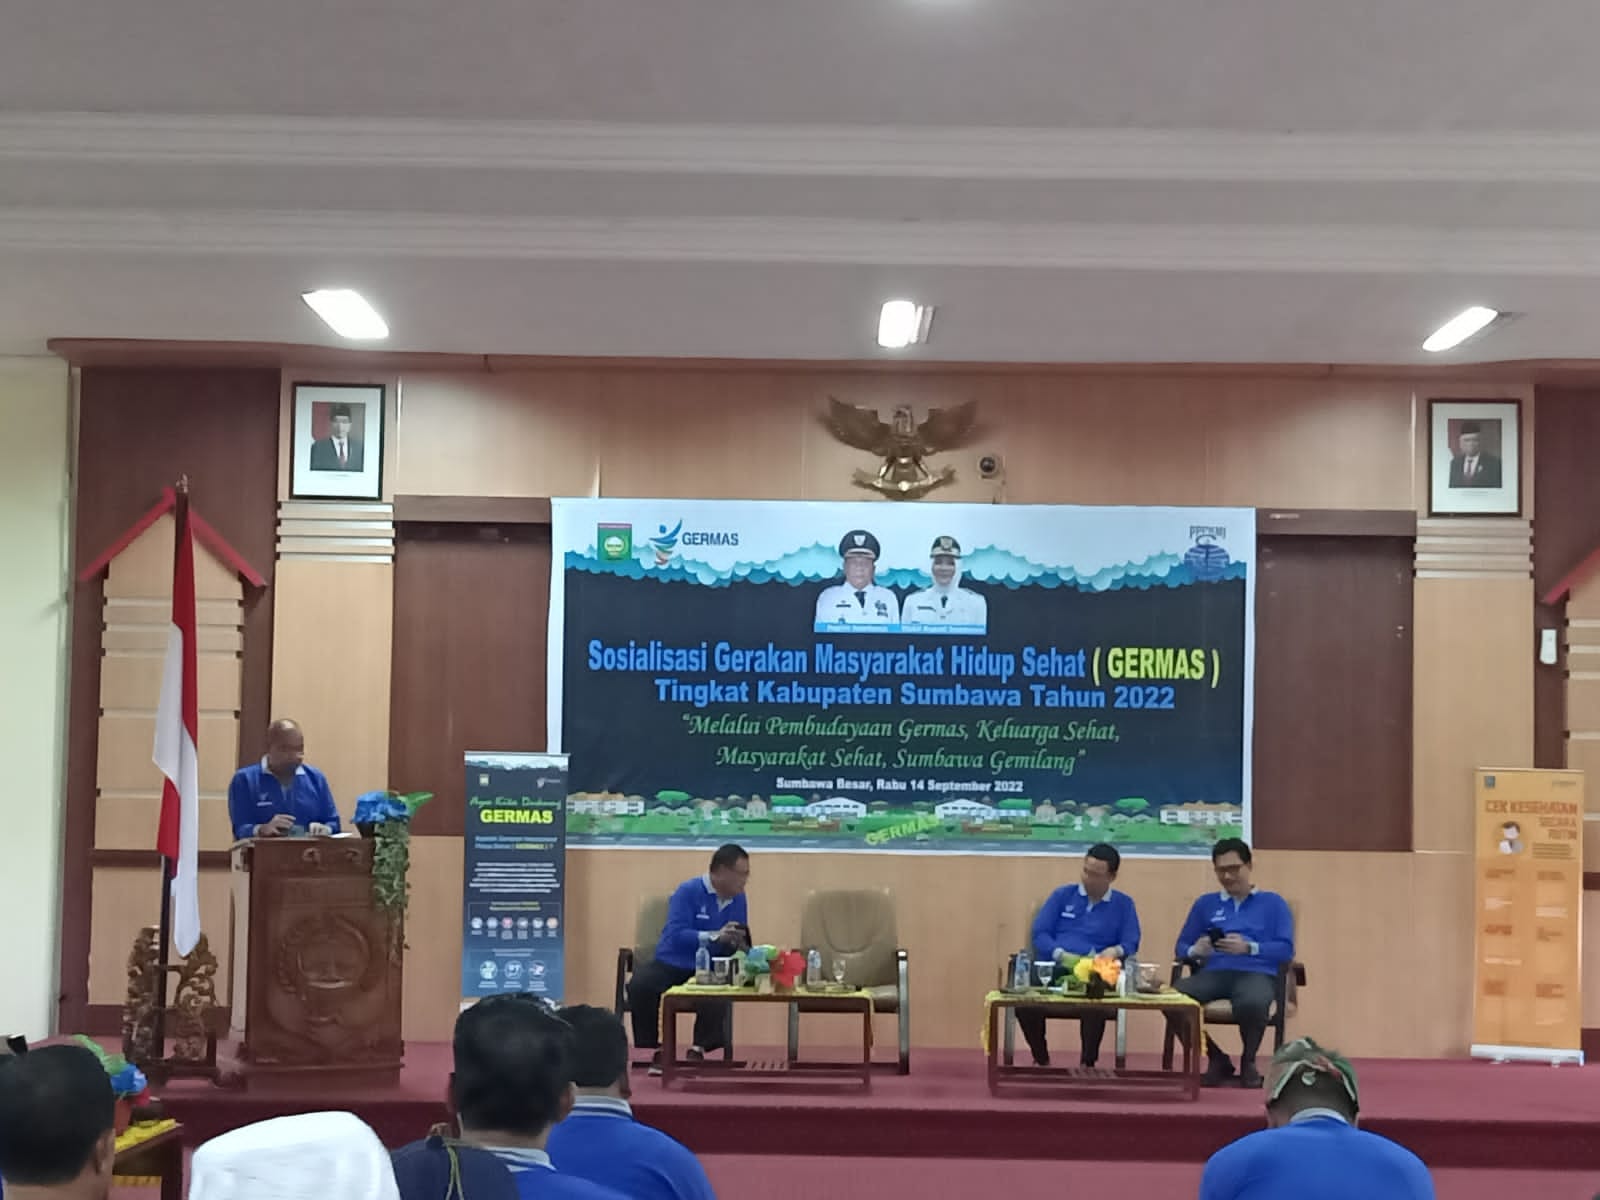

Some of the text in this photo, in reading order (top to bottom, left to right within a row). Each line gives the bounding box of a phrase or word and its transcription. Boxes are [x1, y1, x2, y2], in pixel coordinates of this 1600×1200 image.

[682, 531, 739, 546] GERMAS
[588, 639, 707, 672] Sosialisasi
[714, 641, 807, 673] Gerakan
[815, 643, 944, 682] Masyarakat
[951, 645, 1015, 684] Hidup
[1022, 646, 1086, 678] Sehat
[1107, 648, 1205, 680] GERMAS
[654, 679, 1175, 710] Tingkat Kabupaten Sumbawa Tahun 2022
[765, 714, 893, 743] Pembudayaan
[899, 718, 969, 744] Germas,
[976, 717, 1059, 745] Keluarga
[1063, 719, 1120, 743] Sehat,
[715, 745, 826, 772] Masyarakat
[830, 746, 887, 769] Sehat,
[892, 748, 983, 769] Sumbawa
[776, 777, 1023, 793] Sumbawa Besar, Rabu 14 September 2022
[480, 808, 554, 824] GERMAS
